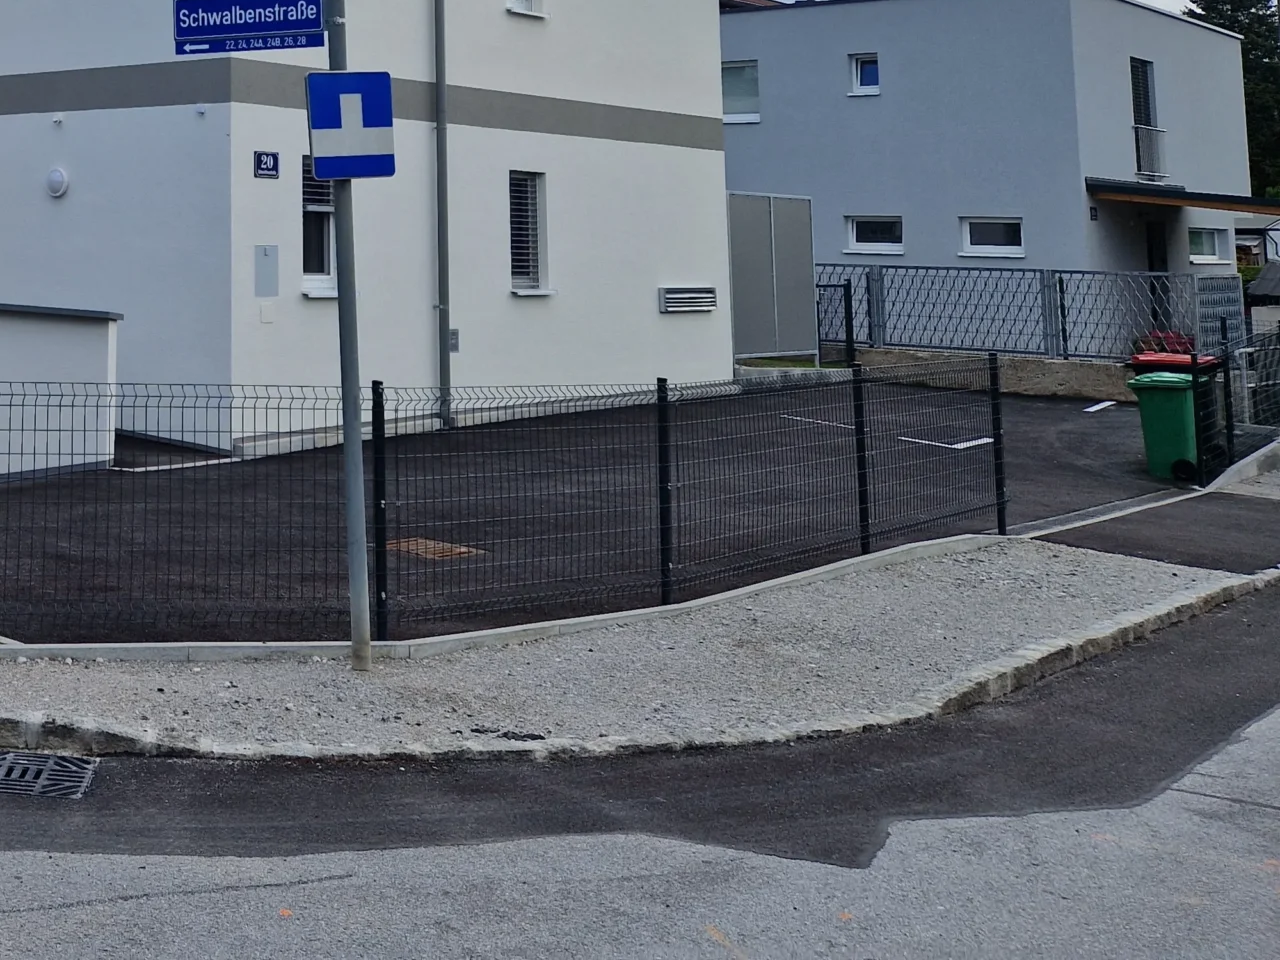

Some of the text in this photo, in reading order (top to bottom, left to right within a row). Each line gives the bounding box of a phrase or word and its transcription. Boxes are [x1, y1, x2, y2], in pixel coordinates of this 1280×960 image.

[179, 0, 317, 28] Schwalbenstraße
[297, 35, 306, 45] 28
[261, 155, 273, 169] 20
